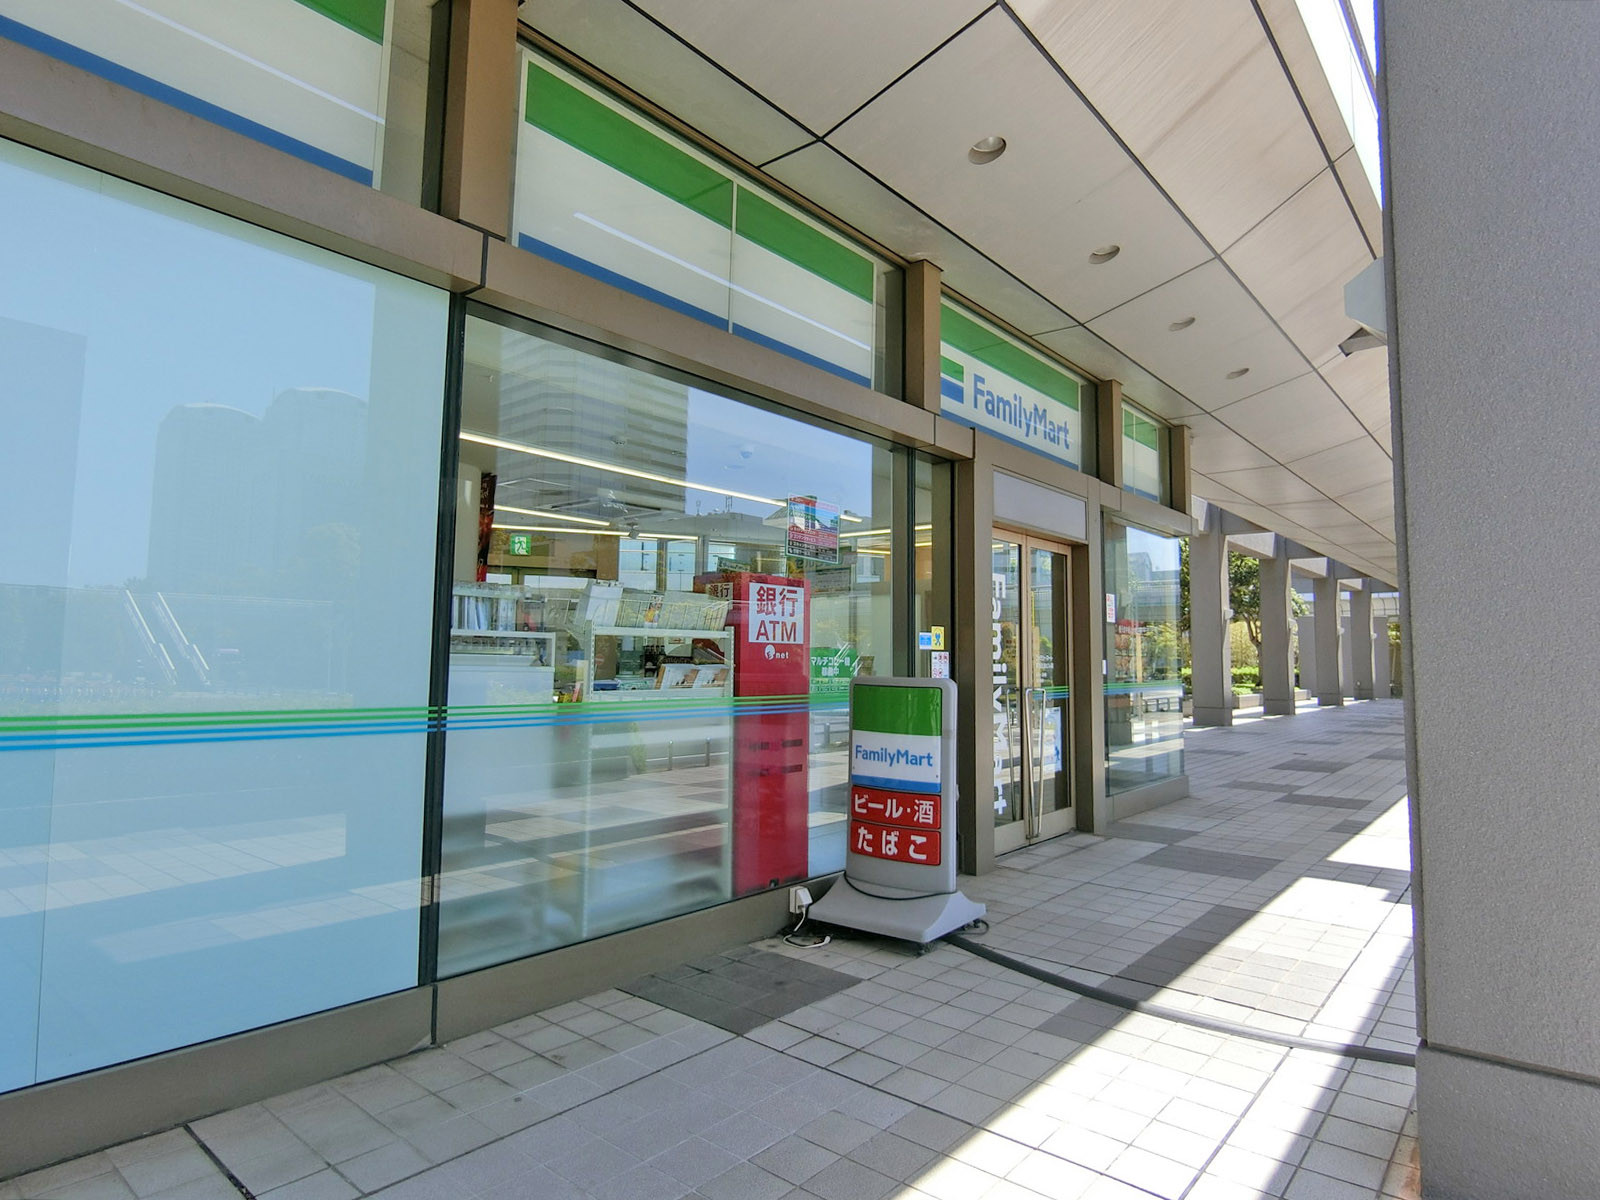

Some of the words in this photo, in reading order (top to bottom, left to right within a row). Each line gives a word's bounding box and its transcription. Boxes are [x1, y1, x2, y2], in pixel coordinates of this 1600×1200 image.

[973, 373, 1070, 450] FamilyMart
[756, 585, 799, 618] 銀行
[755, 619, 797, 643] ATM
[855, 744, 934, 768] FamilyMart
[854, 793, 935, 825] ビール・酒
[857, 825, 928, 861] たばこ
